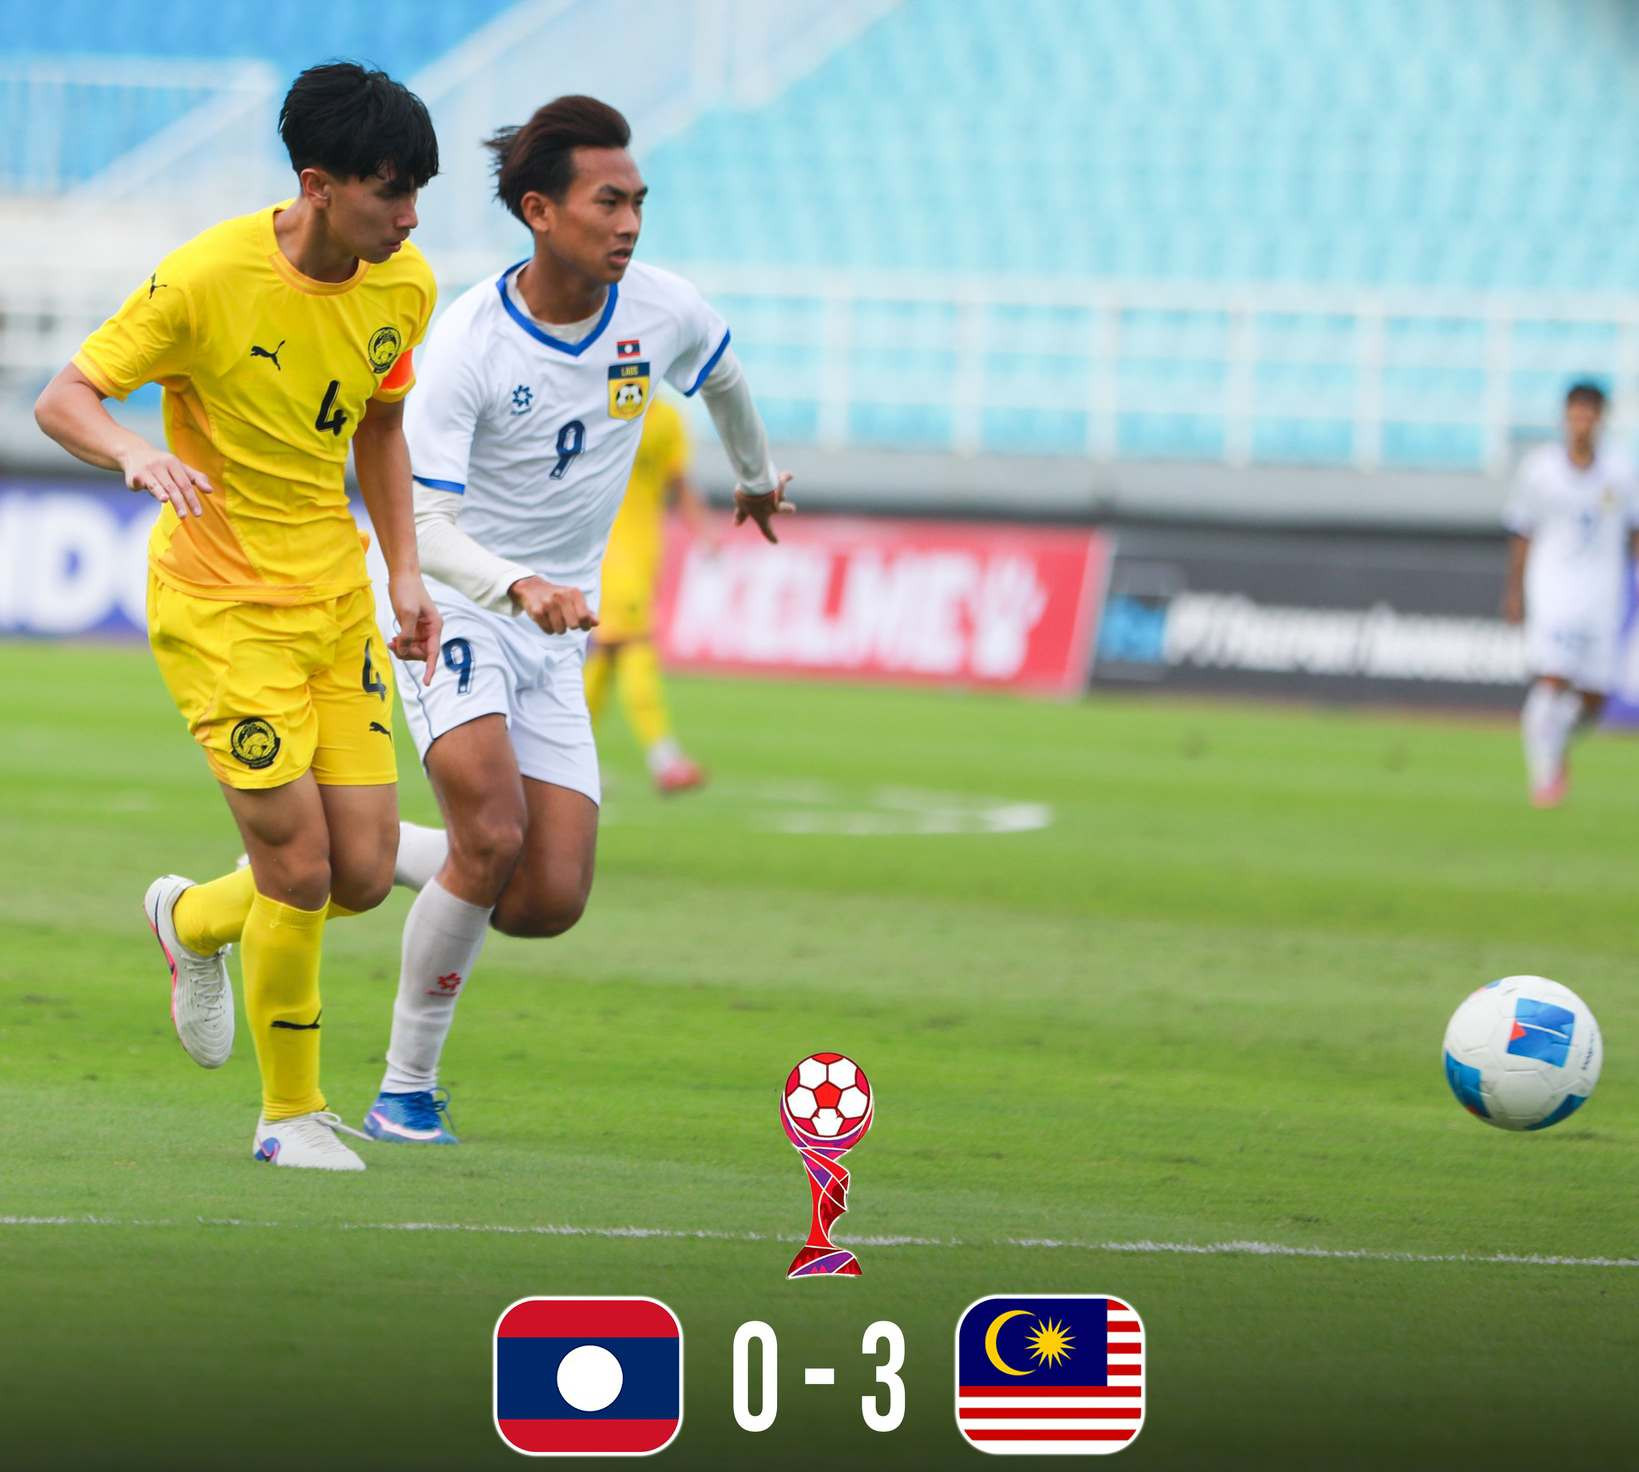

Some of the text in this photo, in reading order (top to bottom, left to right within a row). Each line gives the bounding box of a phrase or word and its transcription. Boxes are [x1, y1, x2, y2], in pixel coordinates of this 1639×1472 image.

[314, 379, 348, 437] 4
[550, 420, 586, 481] 9
[361, 637, 387, 702] 4
[441, 636, 475, 697] 9
